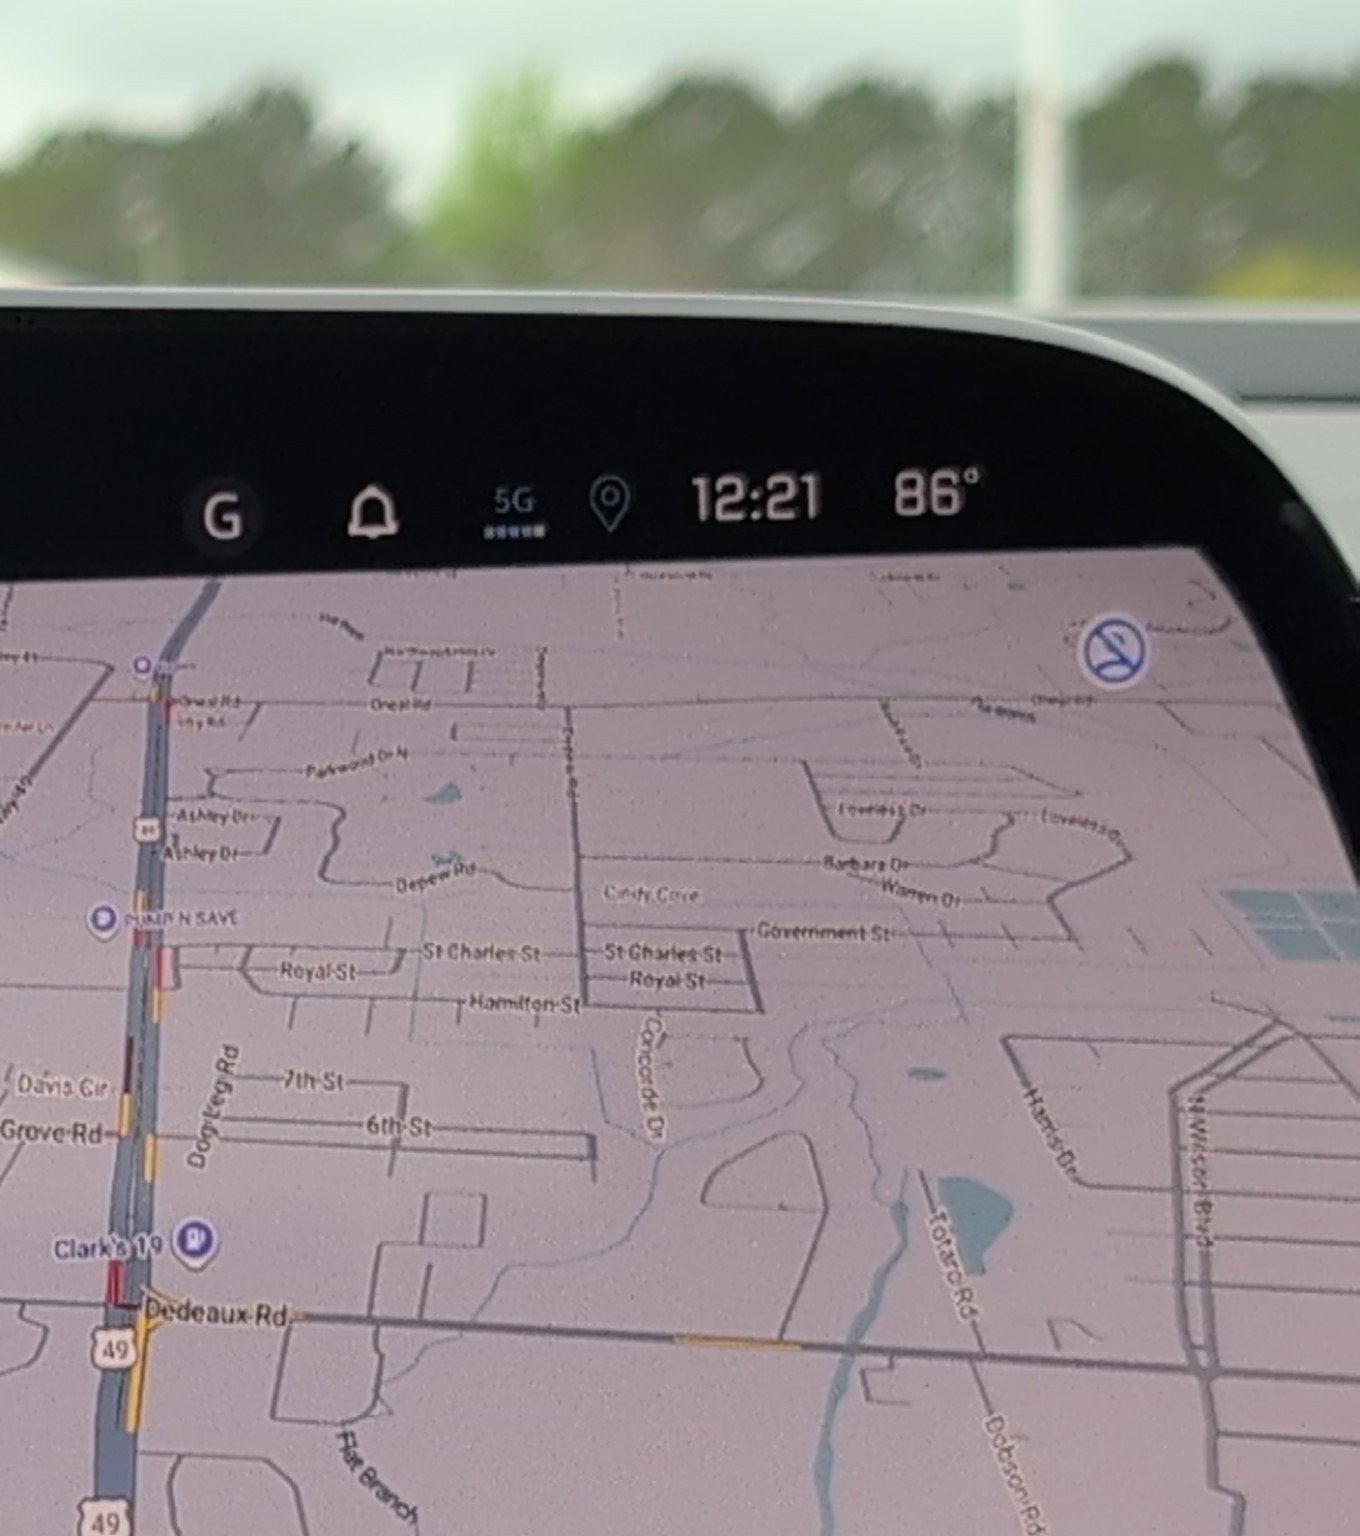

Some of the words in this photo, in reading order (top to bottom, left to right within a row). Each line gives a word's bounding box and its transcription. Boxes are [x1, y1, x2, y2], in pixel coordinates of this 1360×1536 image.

[494, 486, 534, 514] 5G
[691, 473, 821, 523] 12:21
[894, 464, 981, 517] 86°
[203, 492, 242, 540] G
[395, 870, 450, 894] Depew
[452, 862, 476, 878] Rd
[195, 909, 239, 926] SAVE
[757, 921, 866, 940] Government
[871, 926, 892, 942] St
[423, 942, 443, 960] St
[446, 942, 516, 963] Charles
[520, 945, 542, 963] St
[603, 942, 624, 960] St
[629, 943, 698, 963] Charles
[702, 946, 723, 964] St
[281, 960, 330, 982] Royal
[334, 962, 357, 981] St
[630, 970, 681, 992] Royal
[685, 972, 707, 990] St
[469, 992, 556, 1013] Hamilton
[560, 996, 581, 1013] St
[215, 1044, 240, 1076] Rd
[18, 1070, 74, 1096] Davis
[79, 1077, 109, 1097] Cir
[284, 1068, 316, 1089] 7th
[319, 1072, 345, 1092] St
[203, 1075, 234, 1122] Leg
[0, 1117, 66, 1143] Grove
[72, 1120, 103, 1145] Rd
[366, 1115, 402, 1136] 6th
[407, 1119, 432, 1138] St
[187, 1121, 220, 1170] Dog
[54, 1233, 128, 1260] Clark's
[137, 1236, 163, 1256] 19
[145, 1298, 253, 1325] Dedeaux
[255, 1304, 289, 1327] Rd
[102, 1340, 129, 1361] 49
[985, 1414, 1030, 1506] Dobson
[336, 1430, 365, 1474] Flat
[359, 1466, 419, 1525] Branch
[91, 1512, 121, 1536] 49
